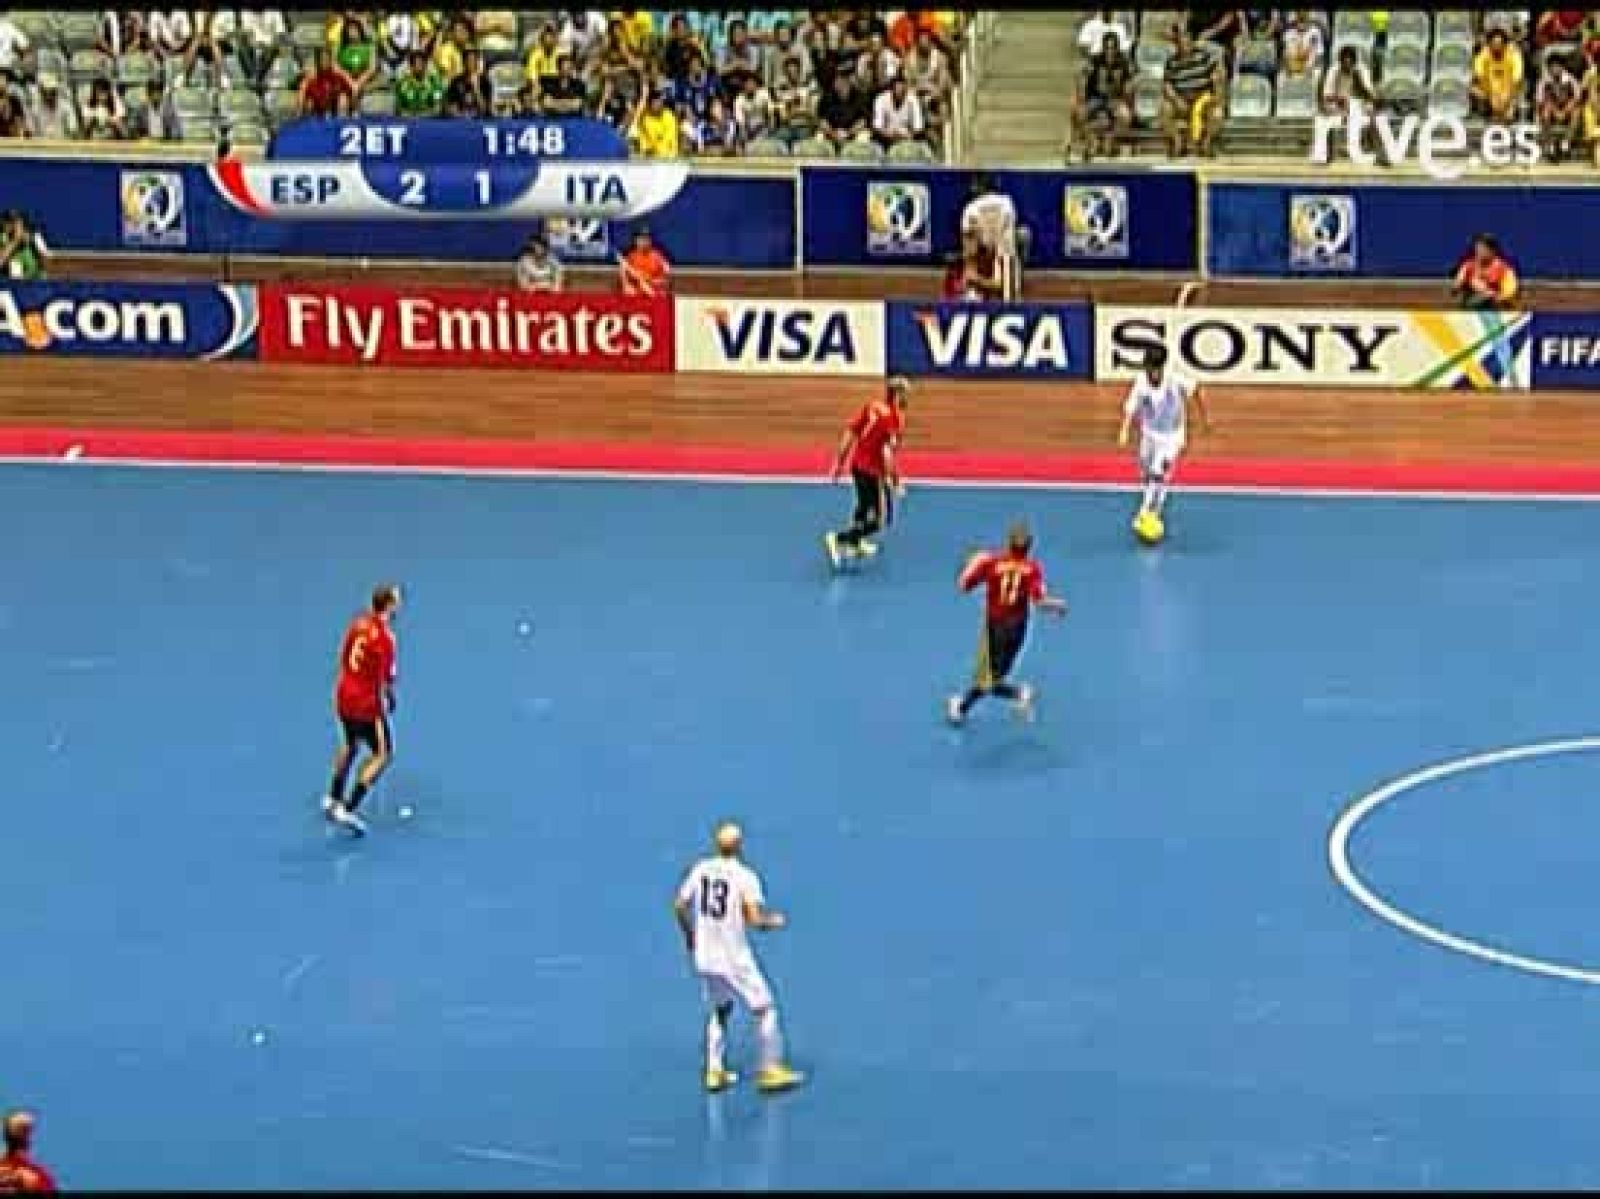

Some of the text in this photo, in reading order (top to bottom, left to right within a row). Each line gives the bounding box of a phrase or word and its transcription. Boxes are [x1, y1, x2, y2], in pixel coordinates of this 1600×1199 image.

[286, 294, 653, 360] Fly Emirates
[704, 307, 858, 363] VISA
[913, 309, 1069, 369] VISA
[1111, 319, 1399, 371] SONY
[700, 875, 729, 920] 13
